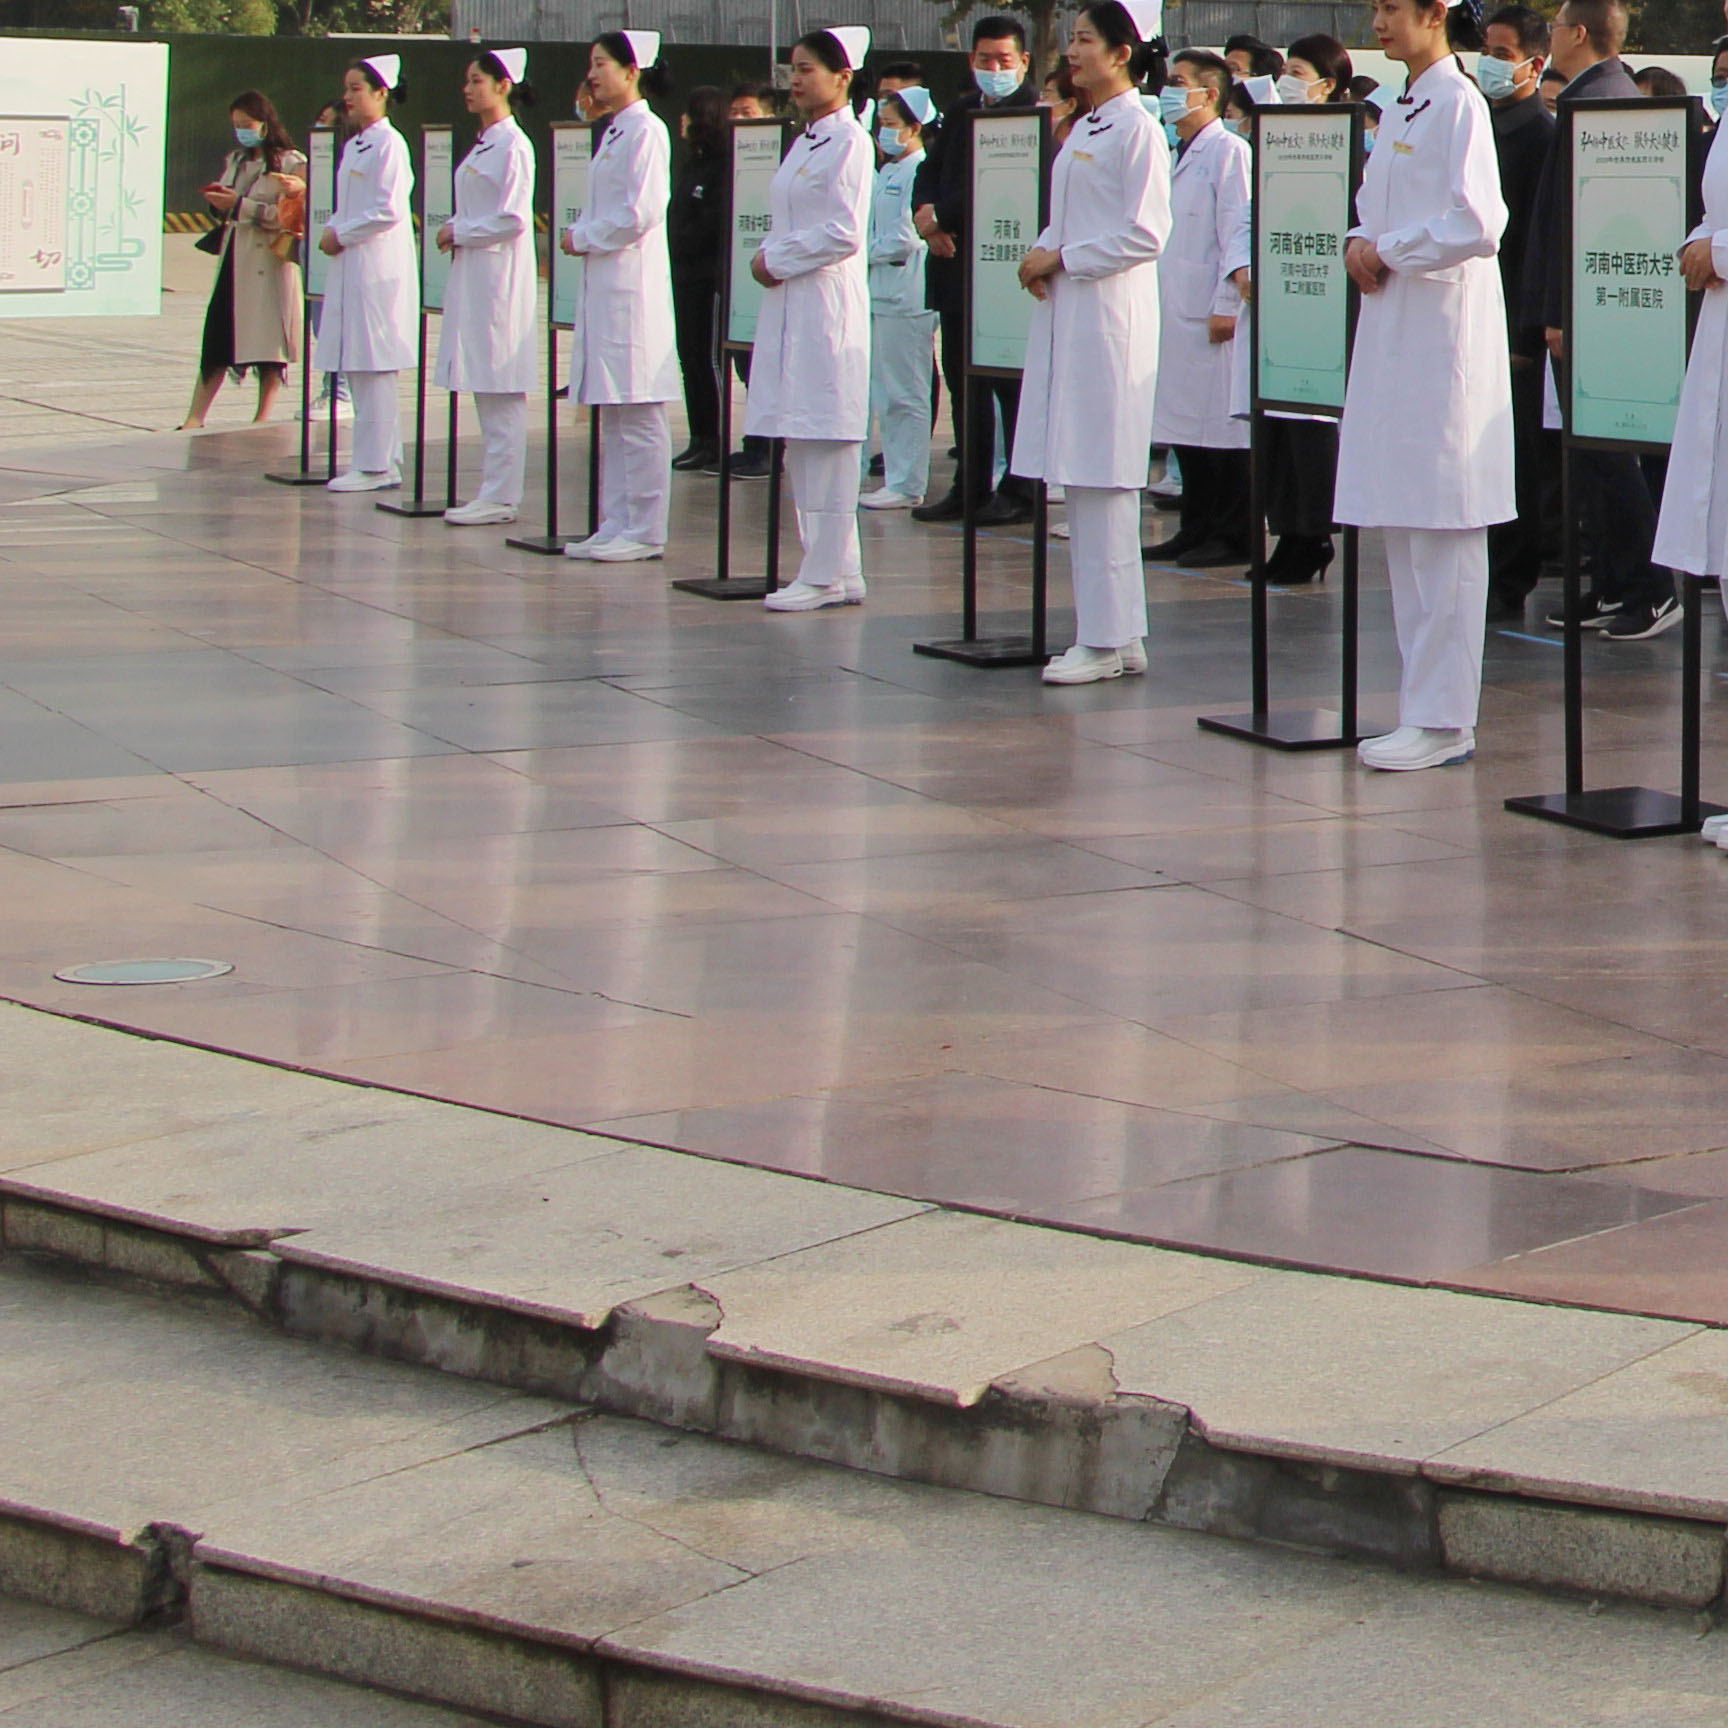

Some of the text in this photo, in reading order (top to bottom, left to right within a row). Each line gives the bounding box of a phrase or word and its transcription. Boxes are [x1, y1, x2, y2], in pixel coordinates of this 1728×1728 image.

[1269, 231, 1338, 256] 河南省中医院
[1584, 251, 1674, 278] 河南中医药大学
[1595, 287, 1664, 310] 第一附属医院
